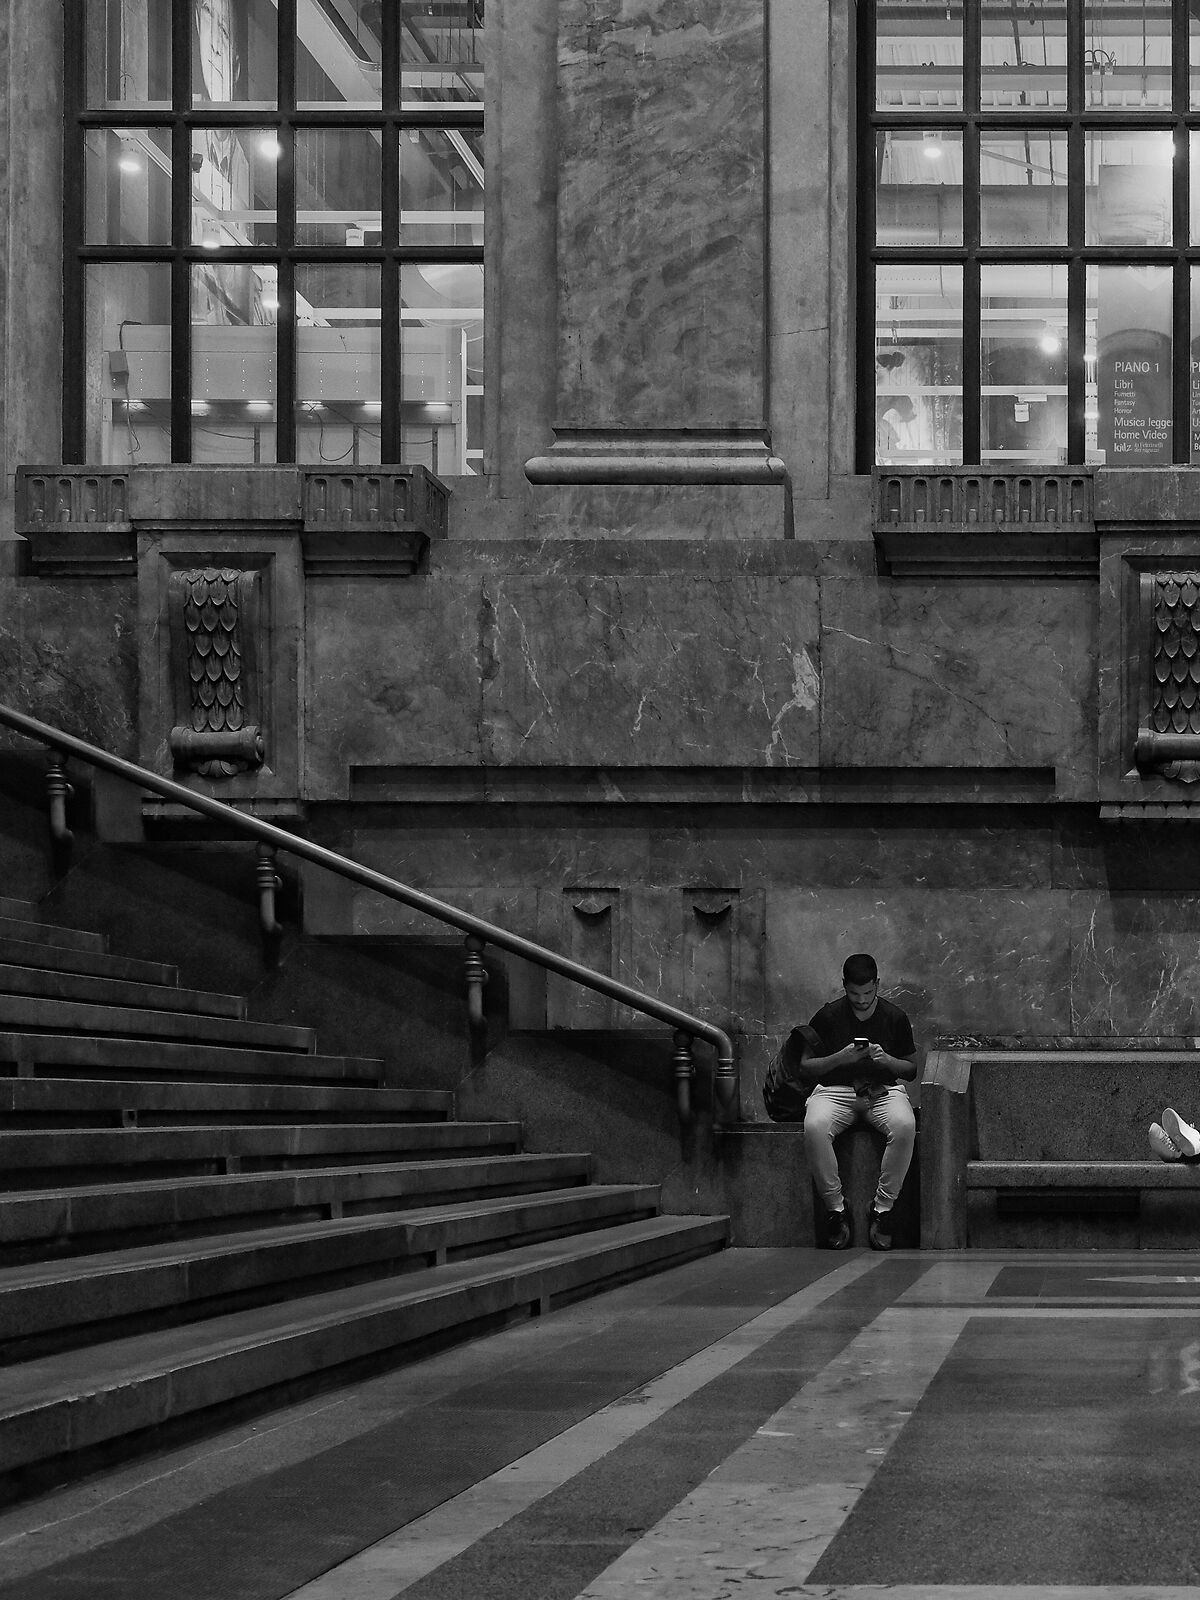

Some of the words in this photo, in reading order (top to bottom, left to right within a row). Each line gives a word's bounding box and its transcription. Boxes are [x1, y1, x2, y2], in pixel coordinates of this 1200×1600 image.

[1114, 361, 1150, 373] PIANO
[1154, 362, 1160, 373] 1
[1114, 379, 1134, 389] Libri
[1114, 417, 1146, 427] Musica
[1114, 430, 1140, 440] Home
[1142, 430, 1168, 440] Video
